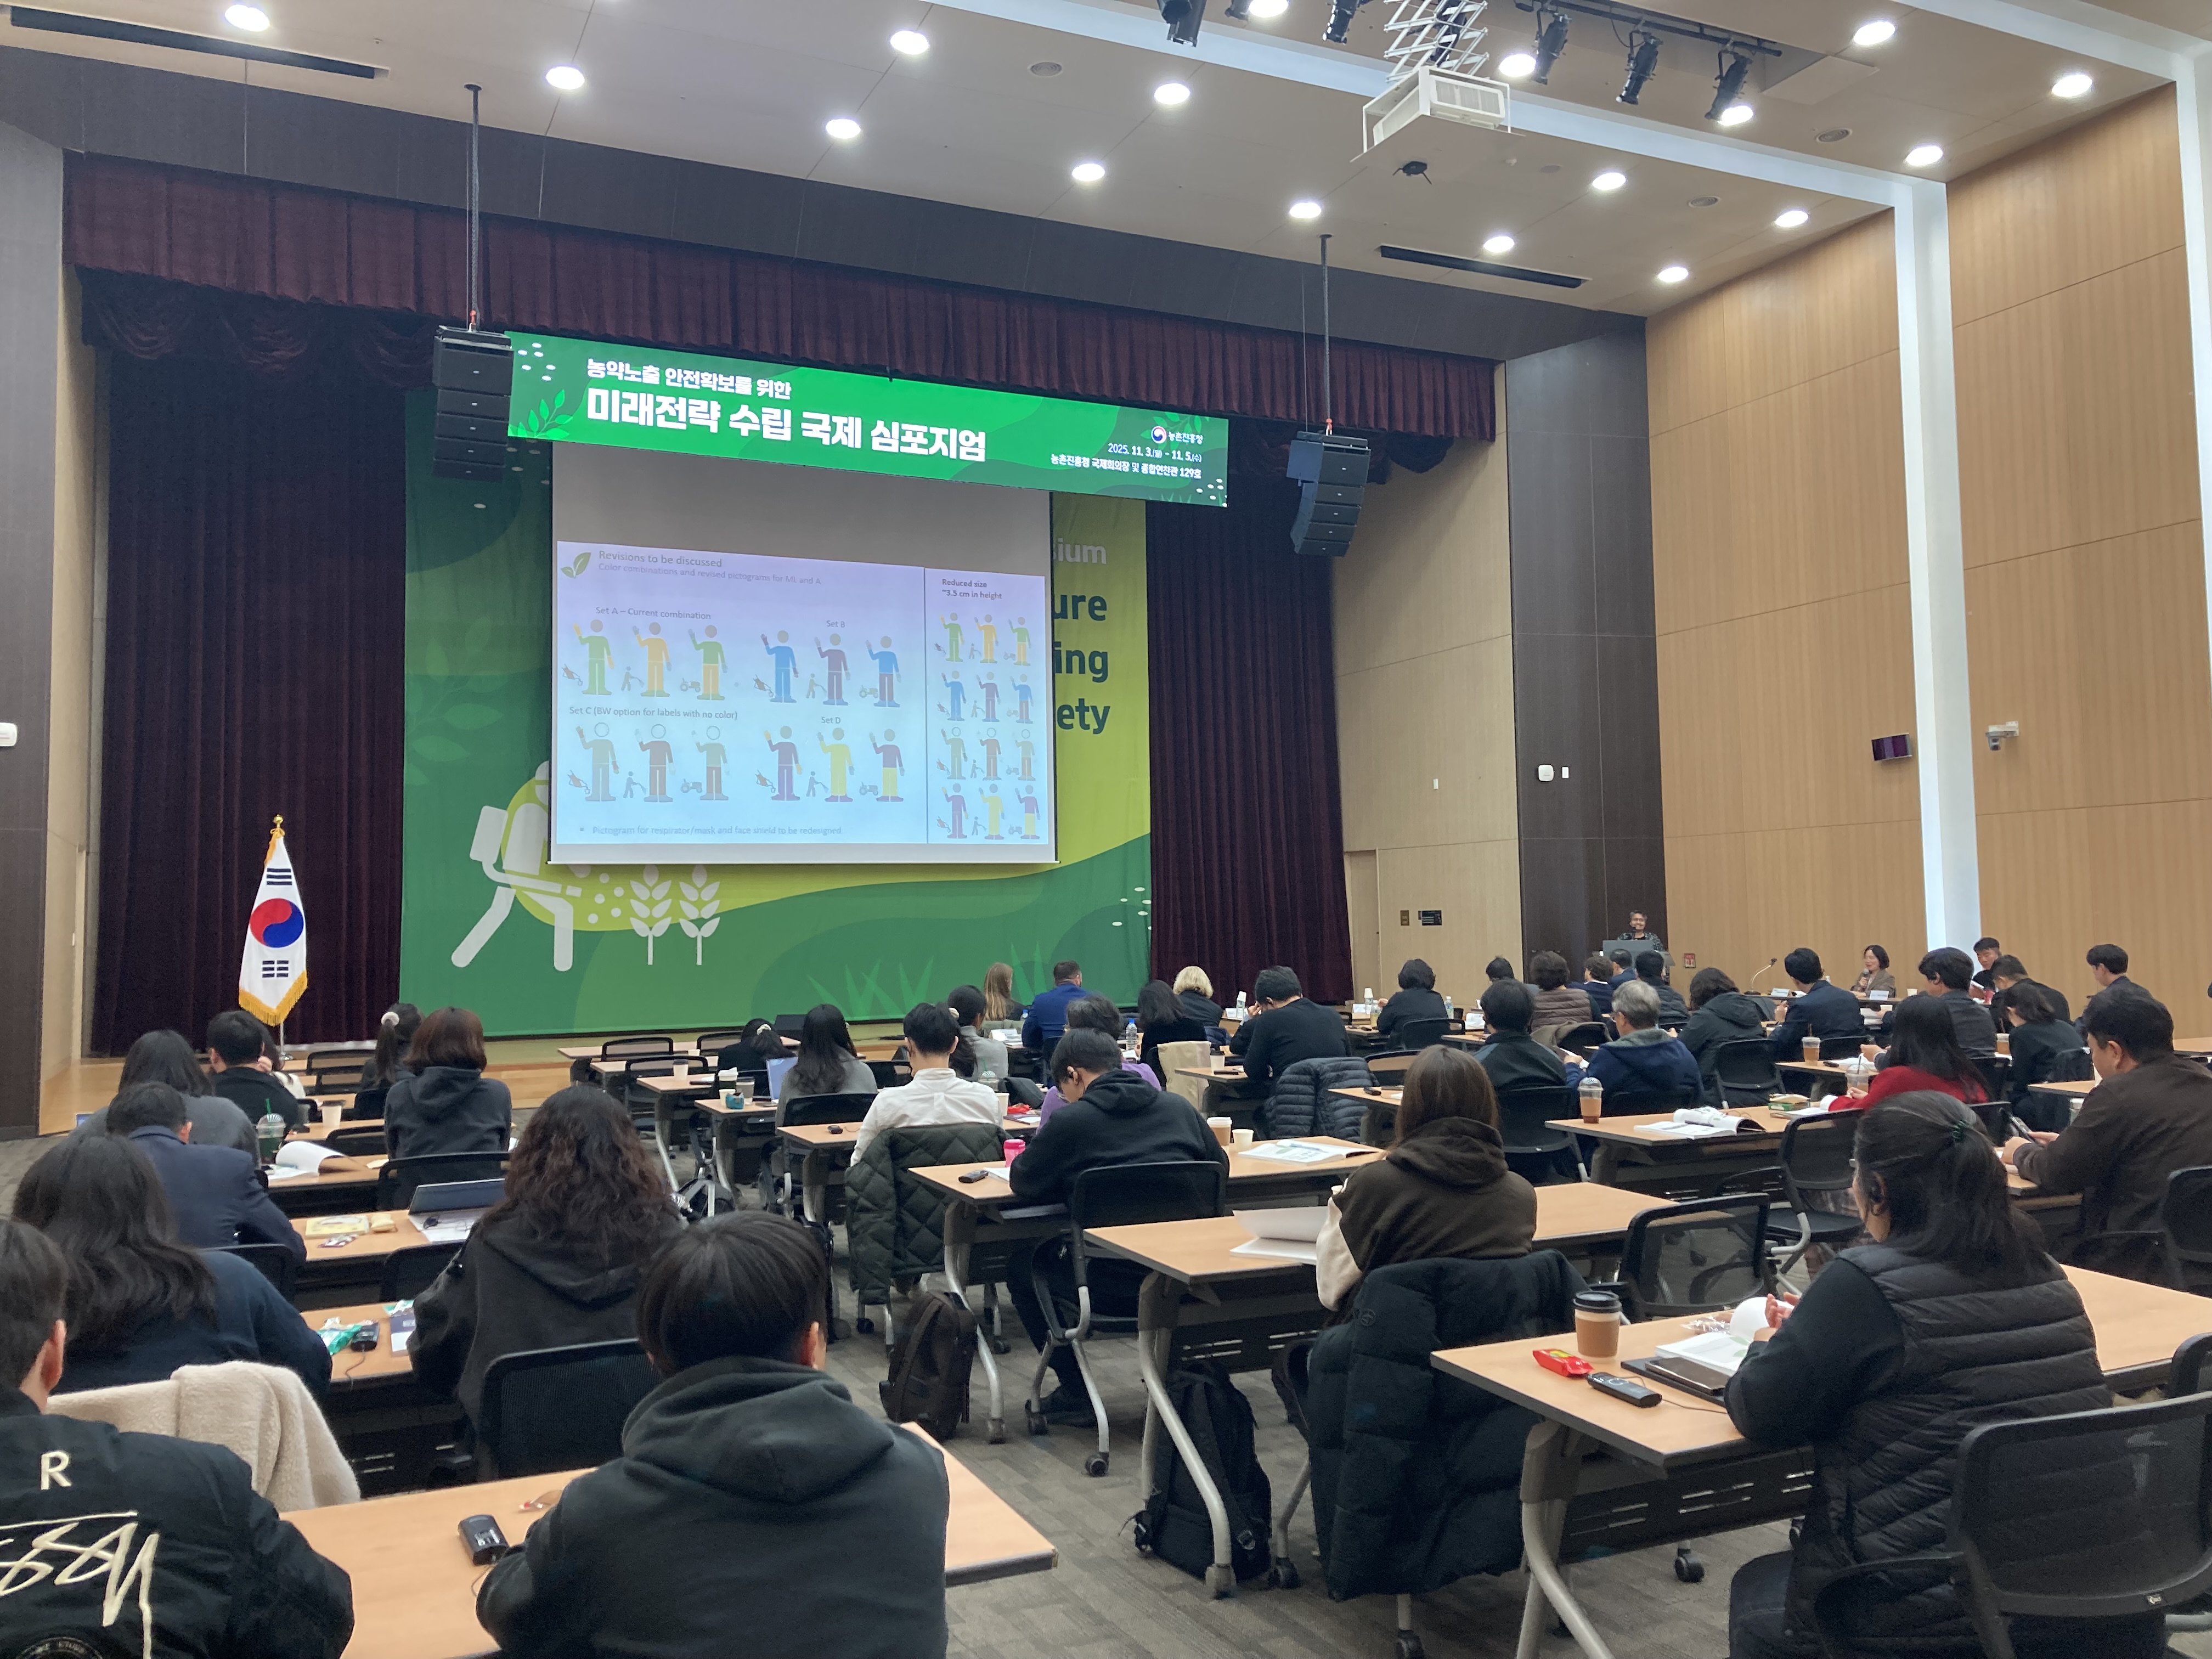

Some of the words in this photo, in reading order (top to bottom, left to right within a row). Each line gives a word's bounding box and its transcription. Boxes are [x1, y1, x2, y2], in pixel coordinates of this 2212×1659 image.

[587, 358, 660, 385] 농약노출
[665, 368, 752, 396] 안전확보를
[757, 379, 792, 400] 위한
[587, 387, 721, 433] 미래전략
[729, 404, 791, 441] 수립
[801, 411, 862, 449] 국제
[871, 420, 986, 462] 심포지엄
[1168, 431, 1203, 445] 농촌진흥청
[1108, 443, 1130, 455] 2025.
[1131, 445, 1144, 456] 11.
[1171, 450, 1184, 461] 11.
[1051, 453, 1090, 468] 농촌진흥청
[1091, 458, 1130, 472] 국제회의장
[1131, 462, 1139, 473] 및
[1180, 467, 1201, 479] 129호
[599, 550, 645, 562] Revisions
[648, 555, 658, 563] to
[661, 555, 673, 564] be
[676, 556, 722, 567] discussed
[1053, 537, 1107, 565] ium
[599, 562, 620, 571] Color
[623, 565, 678, 575] combinations
[697, 570, 725, 578] revised
[728, 572, 770, 582] pictograms
[773, 574, 783, 582] for
[942, 579, 972, 587] Reduced
[980, 591, 1002, 601] height
[595, 606, 609, 614] Set
[628, 608, 658, 617] Current
[661, 610, 711, 619] combination
[1053, 641, 1108, 683] ing
[594, 706, 612, 715] (BW
[613, 708, 641, 716] option
[643, 707, 655, 716] for
[657, 708, 681, 716] labels
[683, 709, 700, 718] with
[714, 710, 738, 720] color)
[1057, 698, 1111, 735] ety
[592, 826, 635, 836] Pictogram
[637, 826, 649, 834] for
[651, 826, 715, 836] respirator/mask
[718, 826, 733, 834] and
[735, 825, 752, 834] face
[753, 826, 776, 834] shield
[778, 826, 786, 834] to
[788, 826, 798, 834] be
[800, 826, 842, 836] redesigned
[40, 1450, 72, 1491] R
